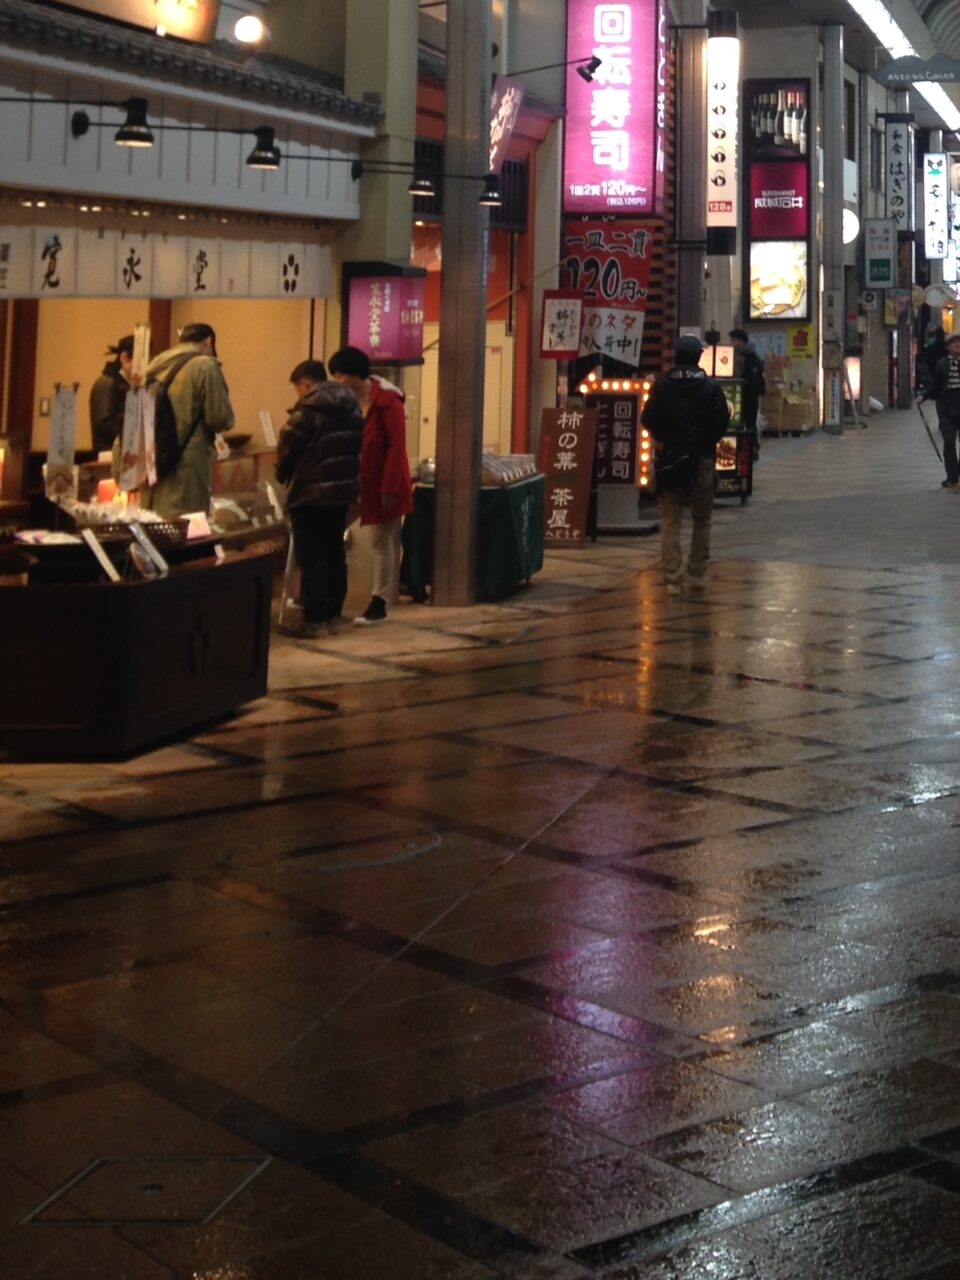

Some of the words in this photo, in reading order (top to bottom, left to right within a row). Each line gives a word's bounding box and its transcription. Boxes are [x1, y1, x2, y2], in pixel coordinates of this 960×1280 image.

[590, 4, 632, 172] 回転寿司
[754, 196, 804, 209] 成城石井
[890, 161, 907, 225] はぎのや
[566, 230, 652, 258] 一皿二貫
[581, 313, 637, 332] のネタ
[553, 410, 584, 472] 柿の葉
[612, 400, 633, 480] 回転寿司
[547, 487, 574, 529] 茶屋
